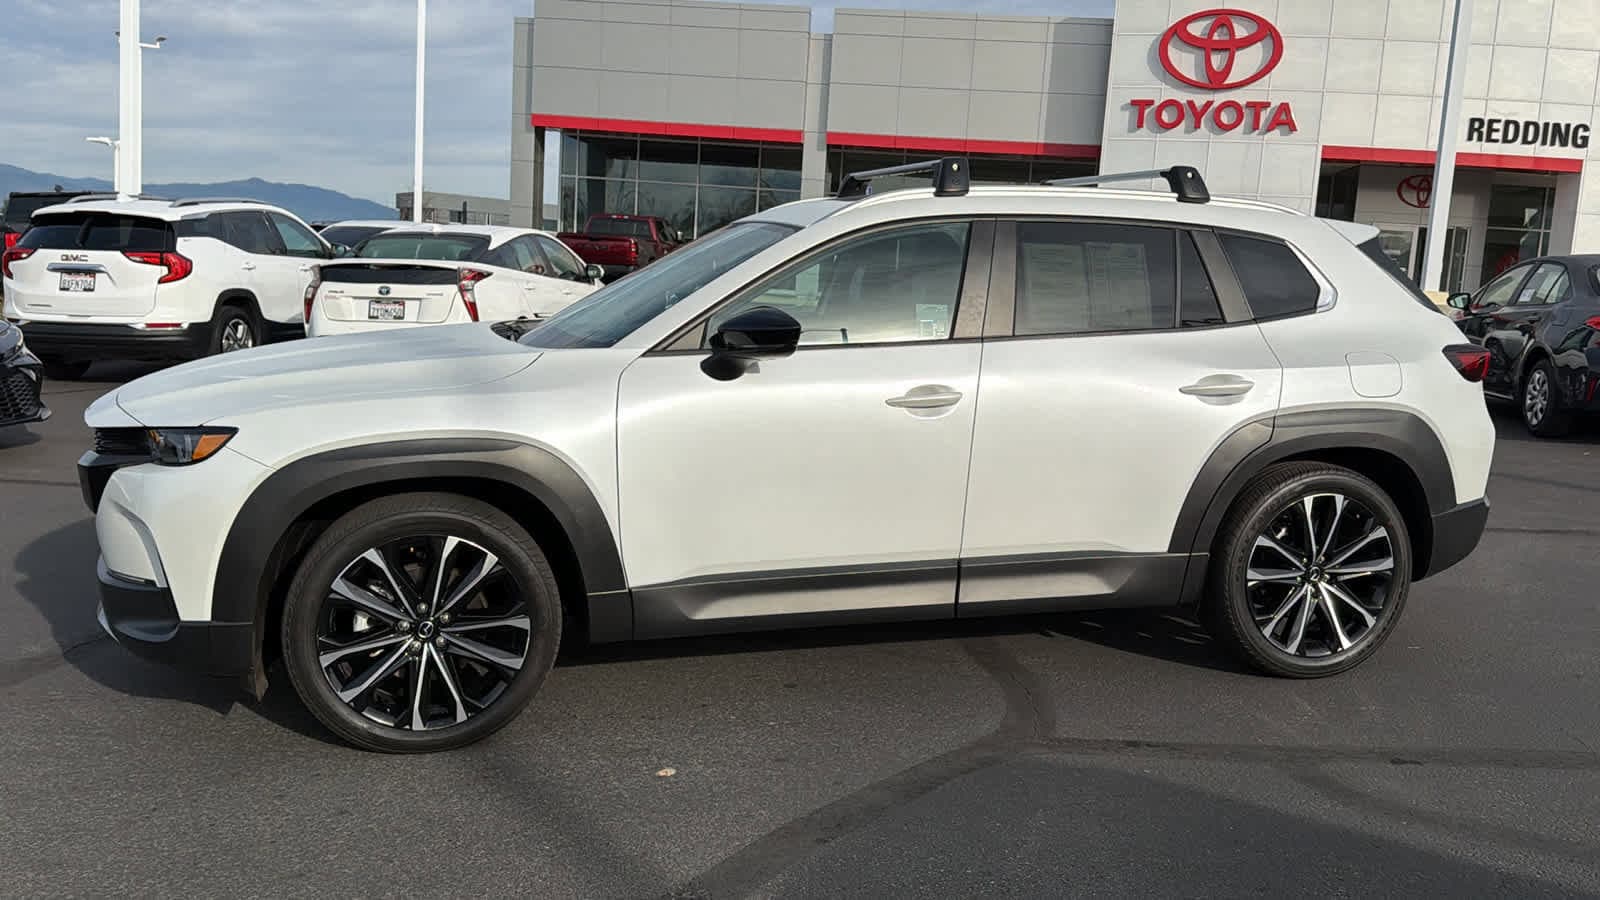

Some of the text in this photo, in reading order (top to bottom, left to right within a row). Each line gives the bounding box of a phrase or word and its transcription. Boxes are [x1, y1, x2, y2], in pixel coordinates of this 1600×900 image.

[1131, 99, 1298, 132] TOYOTA
[1466, 117, 1590, 149] REDDING
[60, 254, 89, 262] GMC
